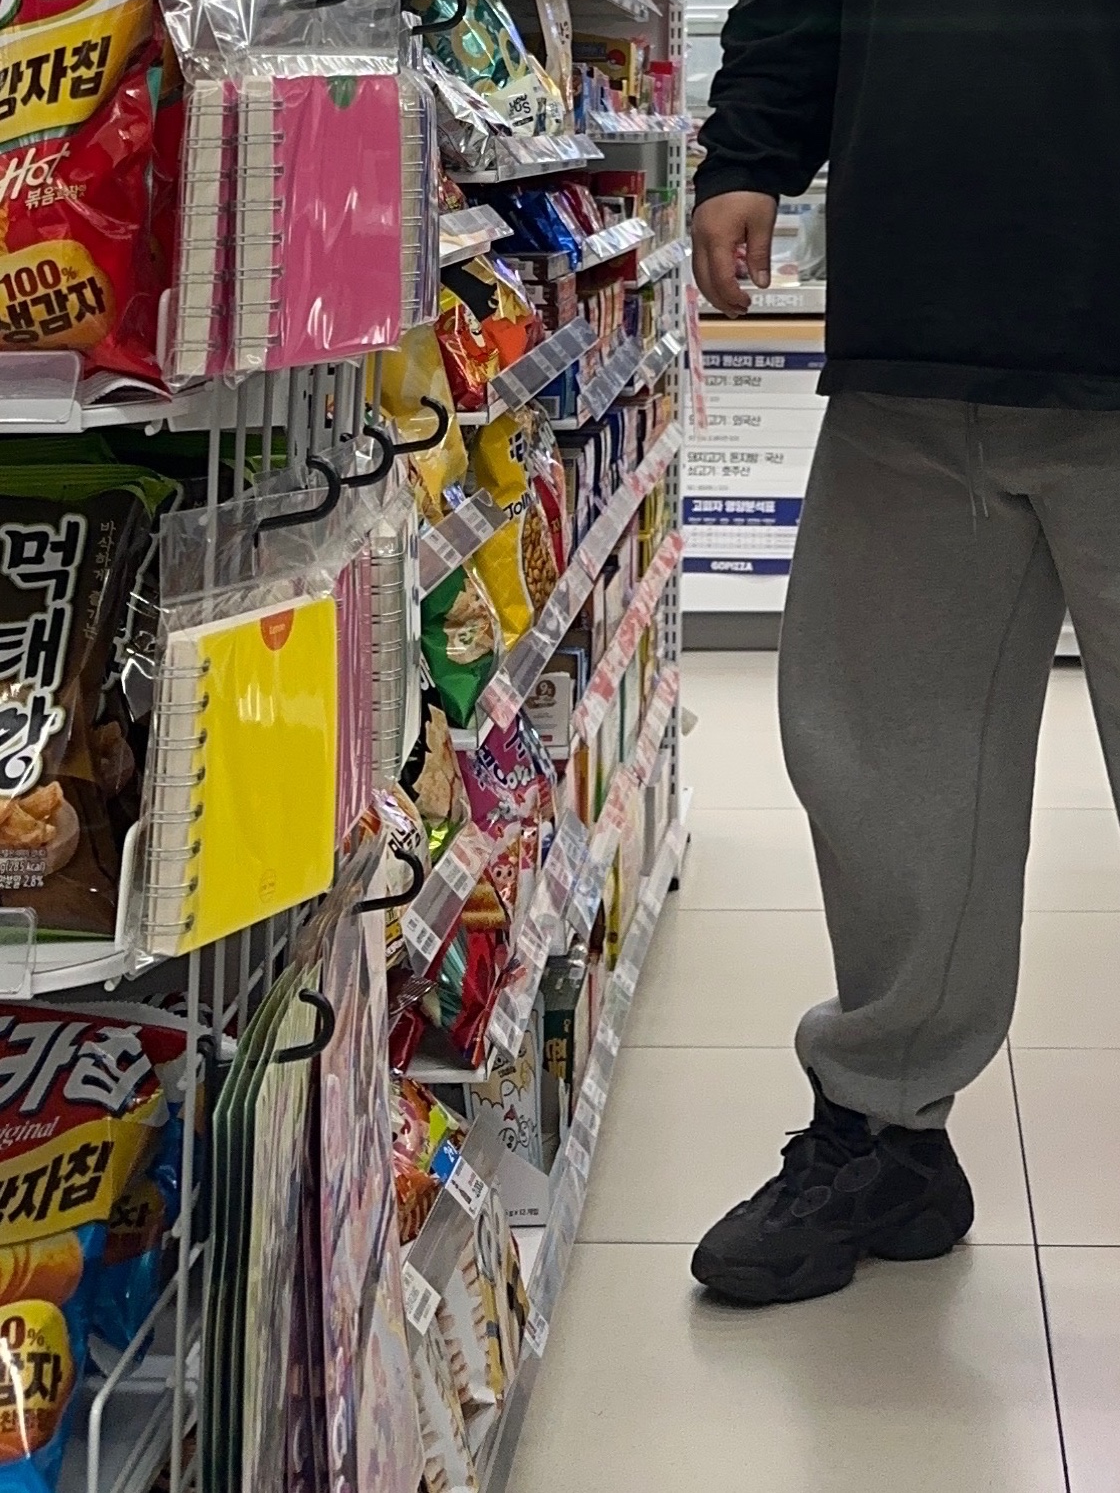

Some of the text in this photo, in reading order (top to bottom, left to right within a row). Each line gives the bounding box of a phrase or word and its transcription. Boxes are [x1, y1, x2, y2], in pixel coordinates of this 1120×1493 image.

[0, 141, 71, 200] Hot
[2, 258, 79, 302] 100%
[0, 1020, 152, 1115] 카칩
